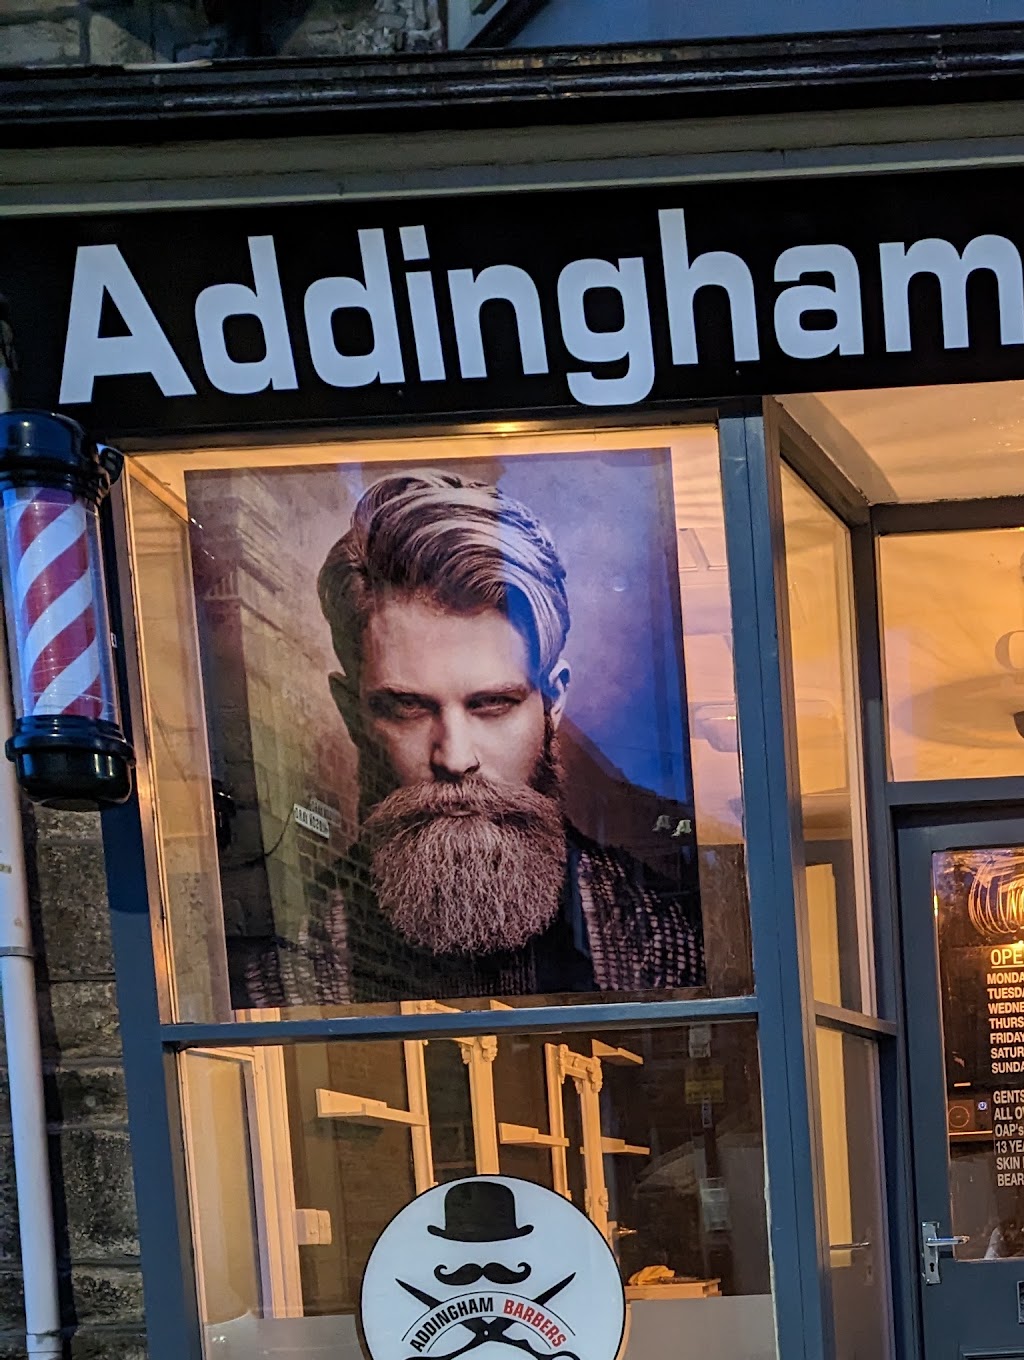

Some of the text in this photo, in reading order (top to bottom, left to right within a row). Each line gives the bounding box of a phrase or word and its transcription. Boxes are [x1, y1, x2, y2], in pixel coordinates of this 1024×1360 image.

[994, 1107, 1013, 1121] ALL
[995, 1123, 1024, 1137] OAP's
[996, 1141, 1008, 1154] 13
[996, 1156, 1020, 1170] SKIN
[410, 1297, 566, 1352] ADDINGHAM BARBERS
